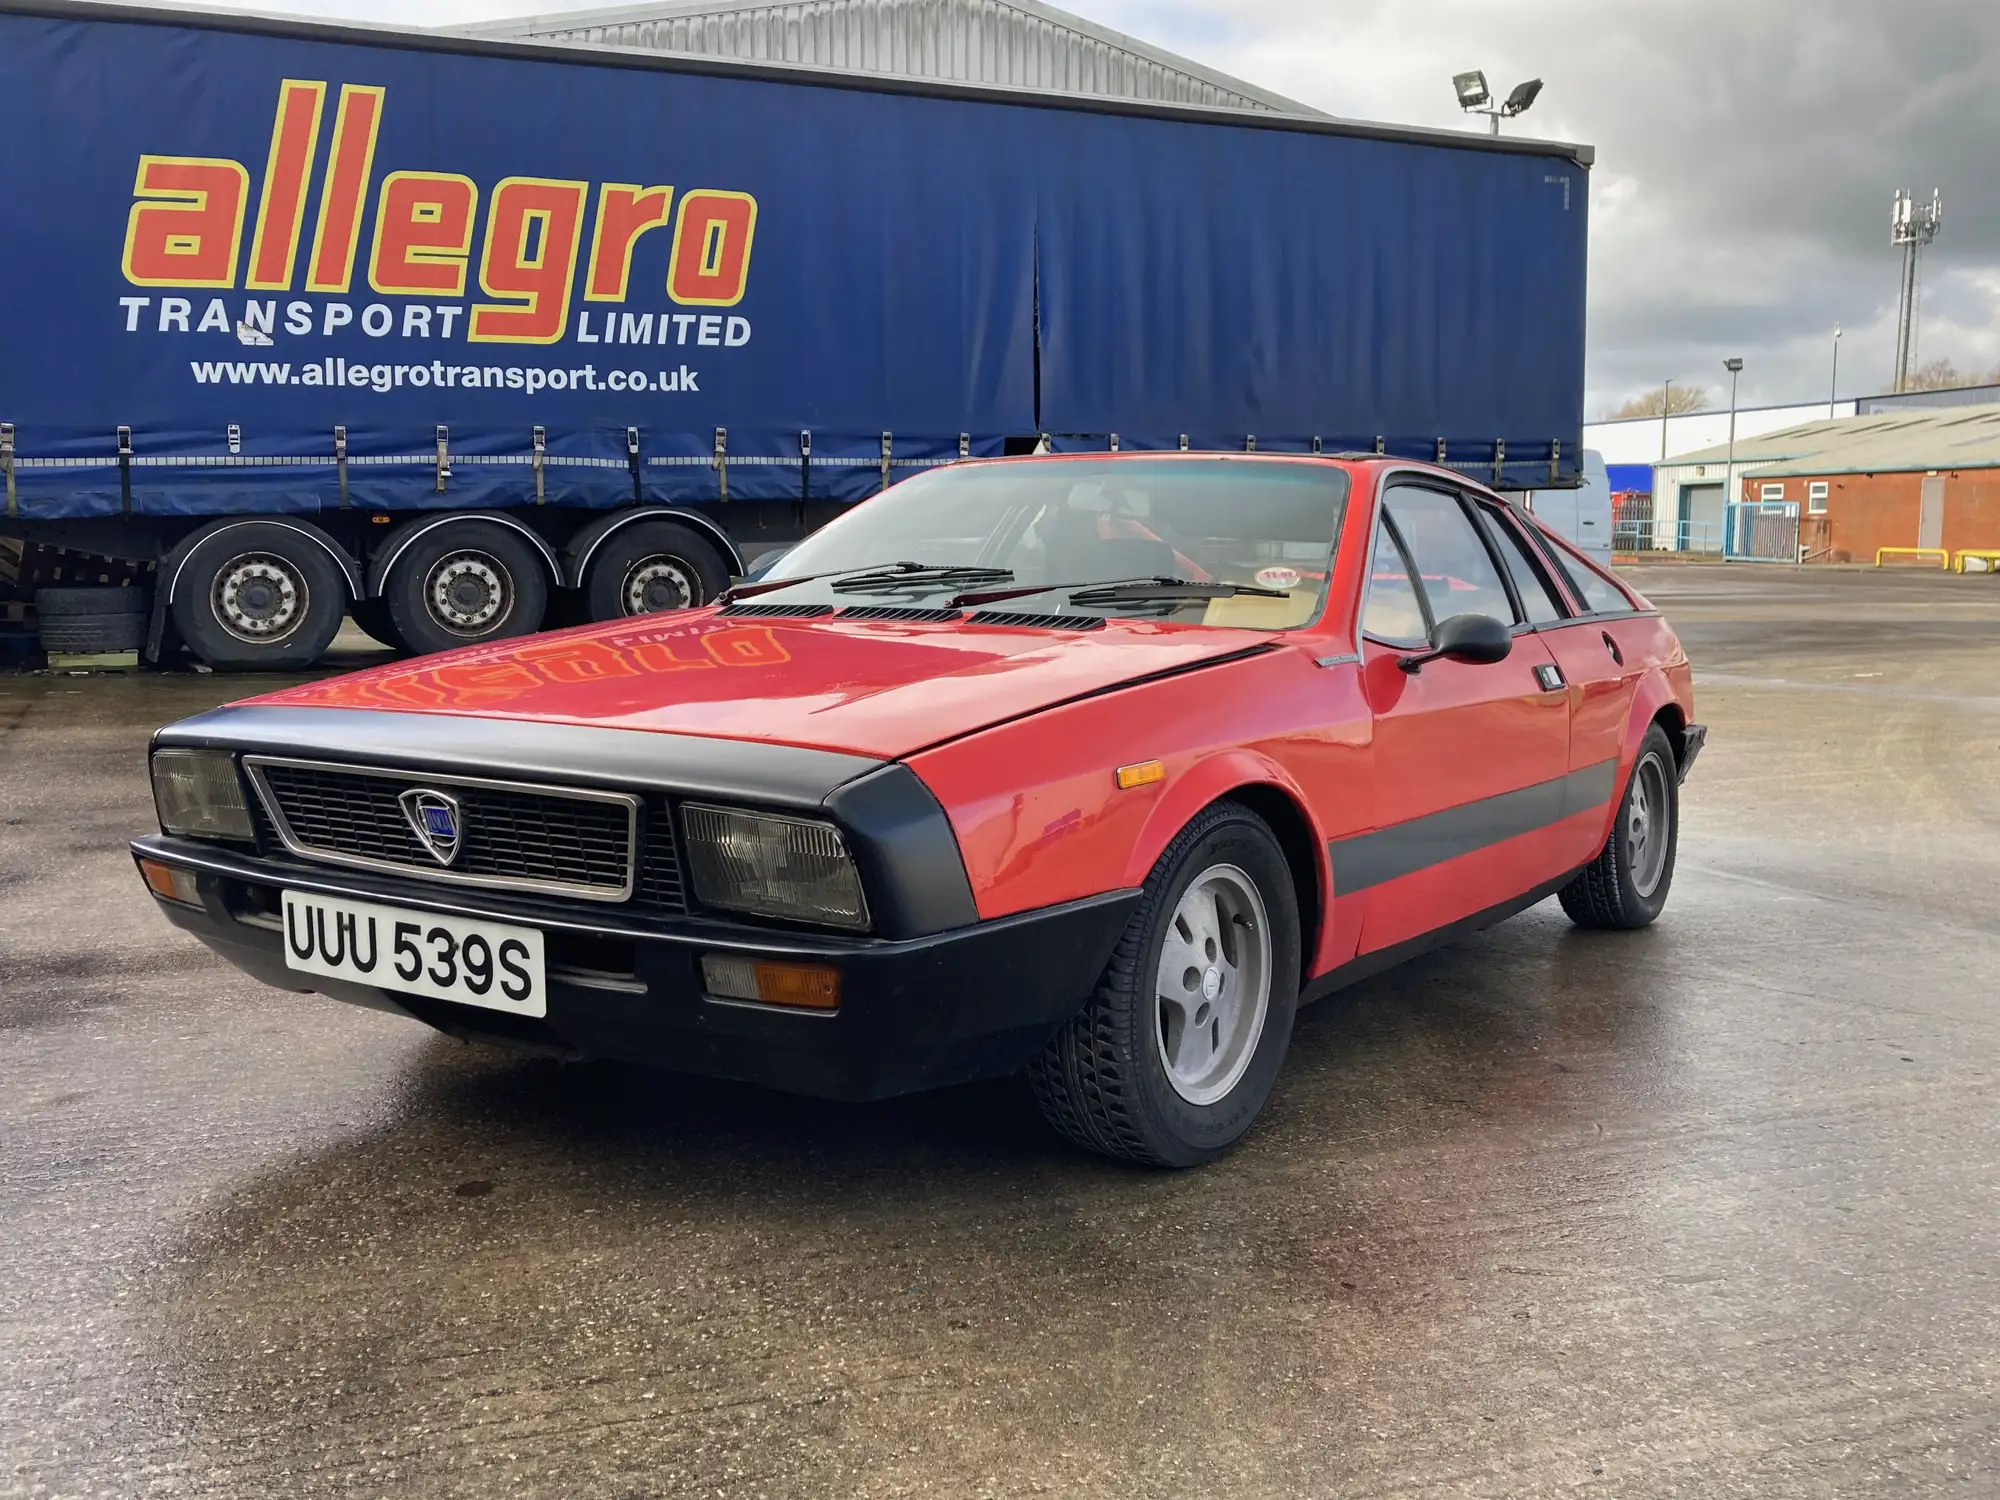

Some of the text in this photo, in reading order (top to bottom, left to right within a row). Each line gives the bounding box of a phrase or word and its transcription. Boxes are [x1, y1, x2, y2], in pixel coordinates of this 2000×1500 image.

[121, 78, 758, 345] allegro
[119, 297, 752, 347] TRANSPORT LIMITED
[190, 357, 700, 394] www.allegrotransport.co.uk
[287, 902, 532, 1001] UUU 539S
